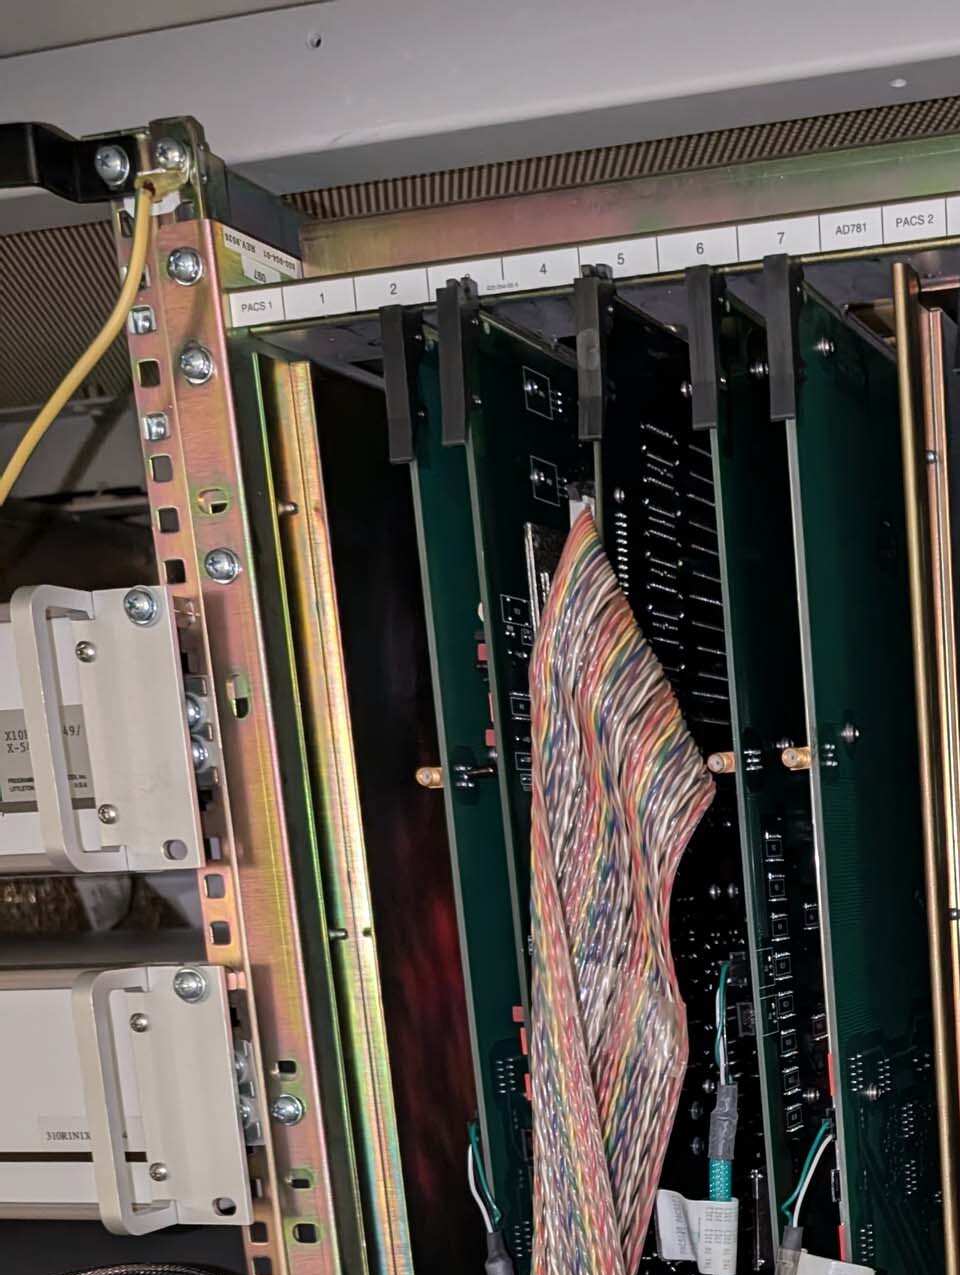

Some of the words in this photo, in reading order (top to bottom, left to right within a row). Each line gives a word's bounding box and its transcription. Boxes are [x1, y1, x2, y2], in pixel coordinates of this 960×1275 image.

[895, 214, 926, 228] PACS
[927, 213, 934, 225] 2
[835, 222, 867, 236] AD781
[776, 231, 785, 245] 7
[695, 242, 705, 255] 6
[616, 252, 625, 266] 5
[539, 263, 548, 275] 4
[389, 283, 398, 296] 2
[319, 292, 325, 305] 1
[241, 301, 266, 313] PACS
